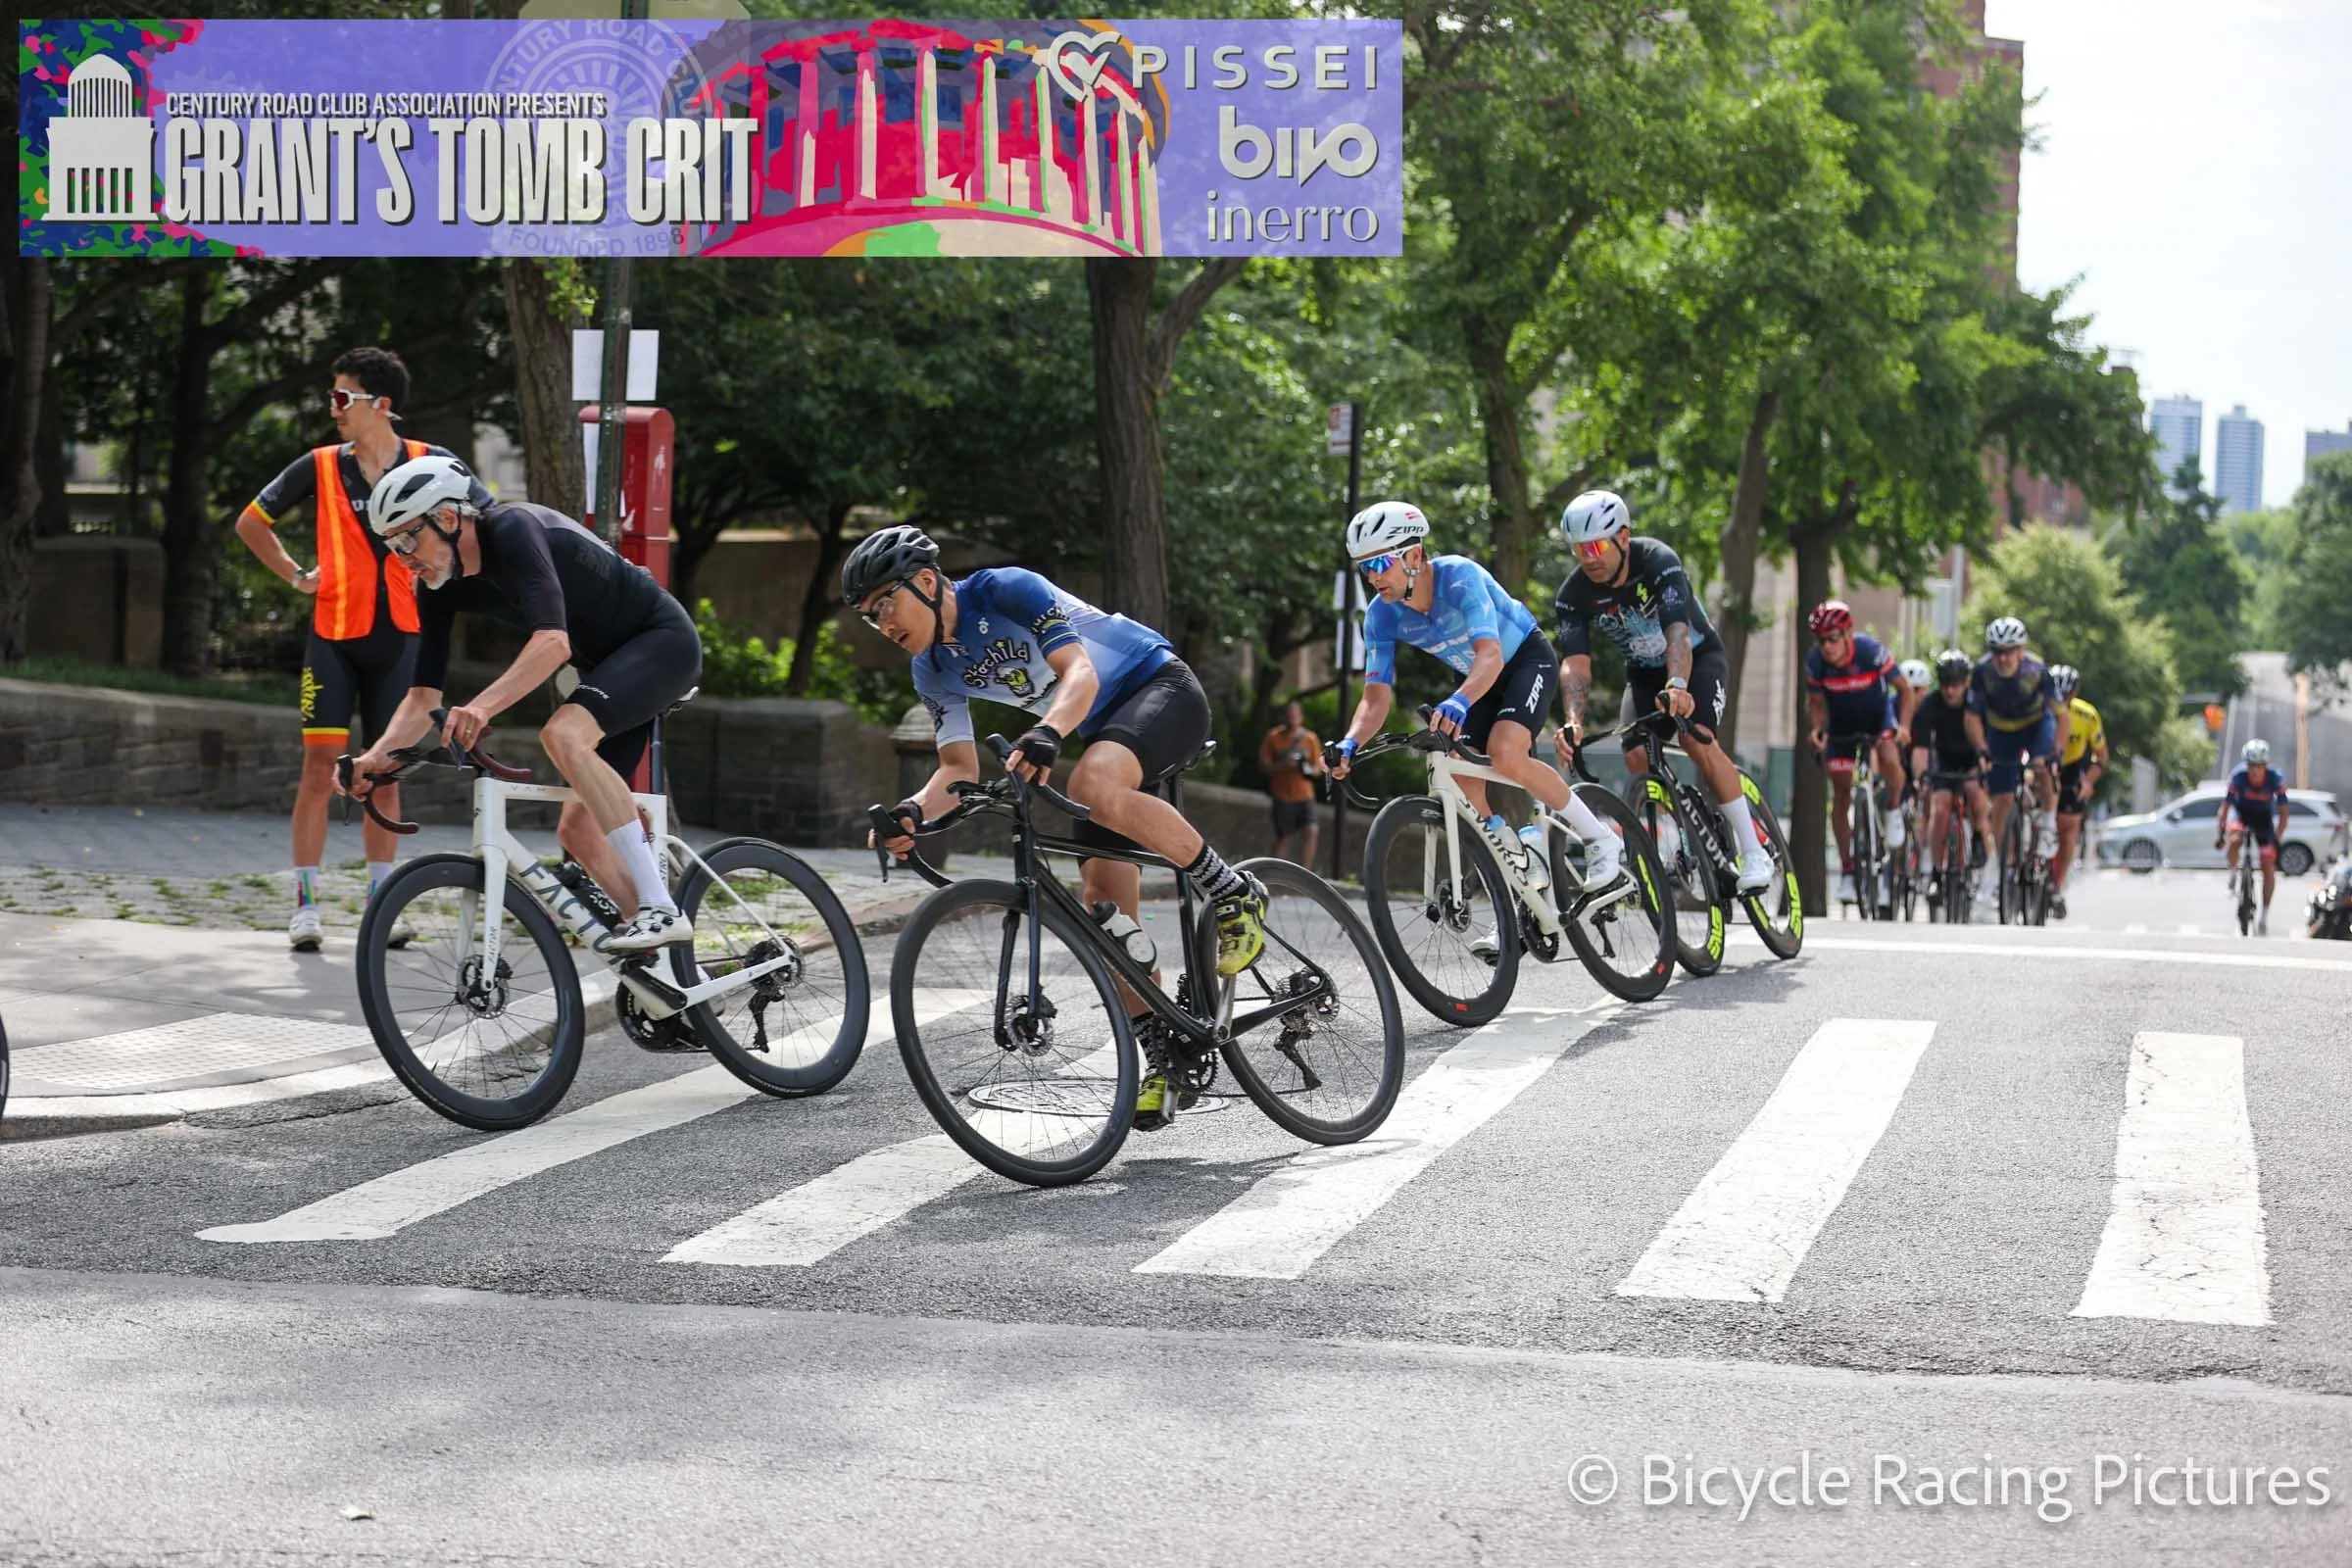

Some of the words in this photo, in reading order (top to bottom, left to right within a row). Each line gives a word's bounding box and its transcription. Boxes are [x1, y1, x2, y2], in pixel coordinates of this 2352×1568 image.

[1388, 525, 1424, 535] ZIPP
[1525, 673, 1545, 714] ZIPP
[519, 860, 623, 965] FACTO
